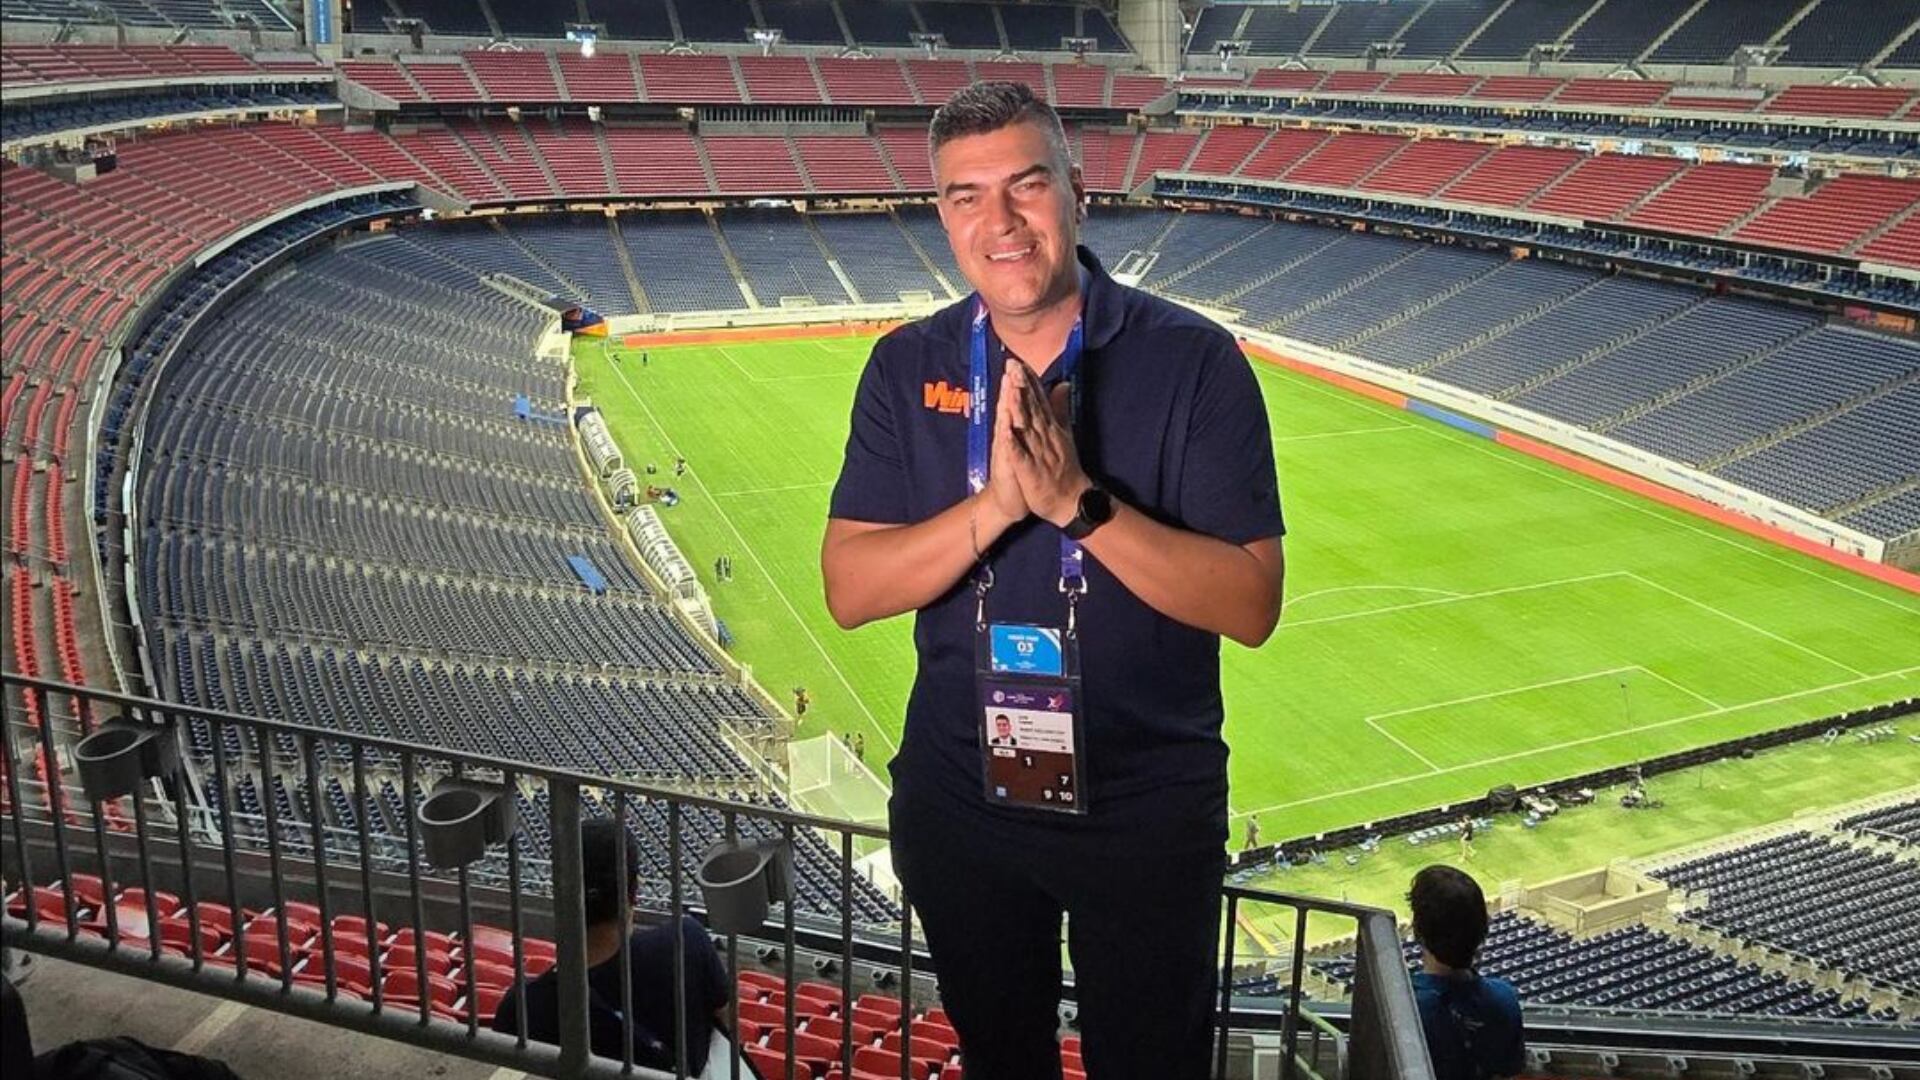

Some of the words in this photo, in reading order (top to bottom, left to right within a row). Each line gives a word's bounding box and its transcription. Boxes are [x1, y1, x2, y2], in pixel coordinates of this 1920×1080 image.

[1017, 641, 1034, 653] 03
[1025, 756, 1032, 766] 1
[1061, 775, 1069, 785] 7
[1044, 789, 1052, 799] 9
[1059, 792, 1073, 801] 10
